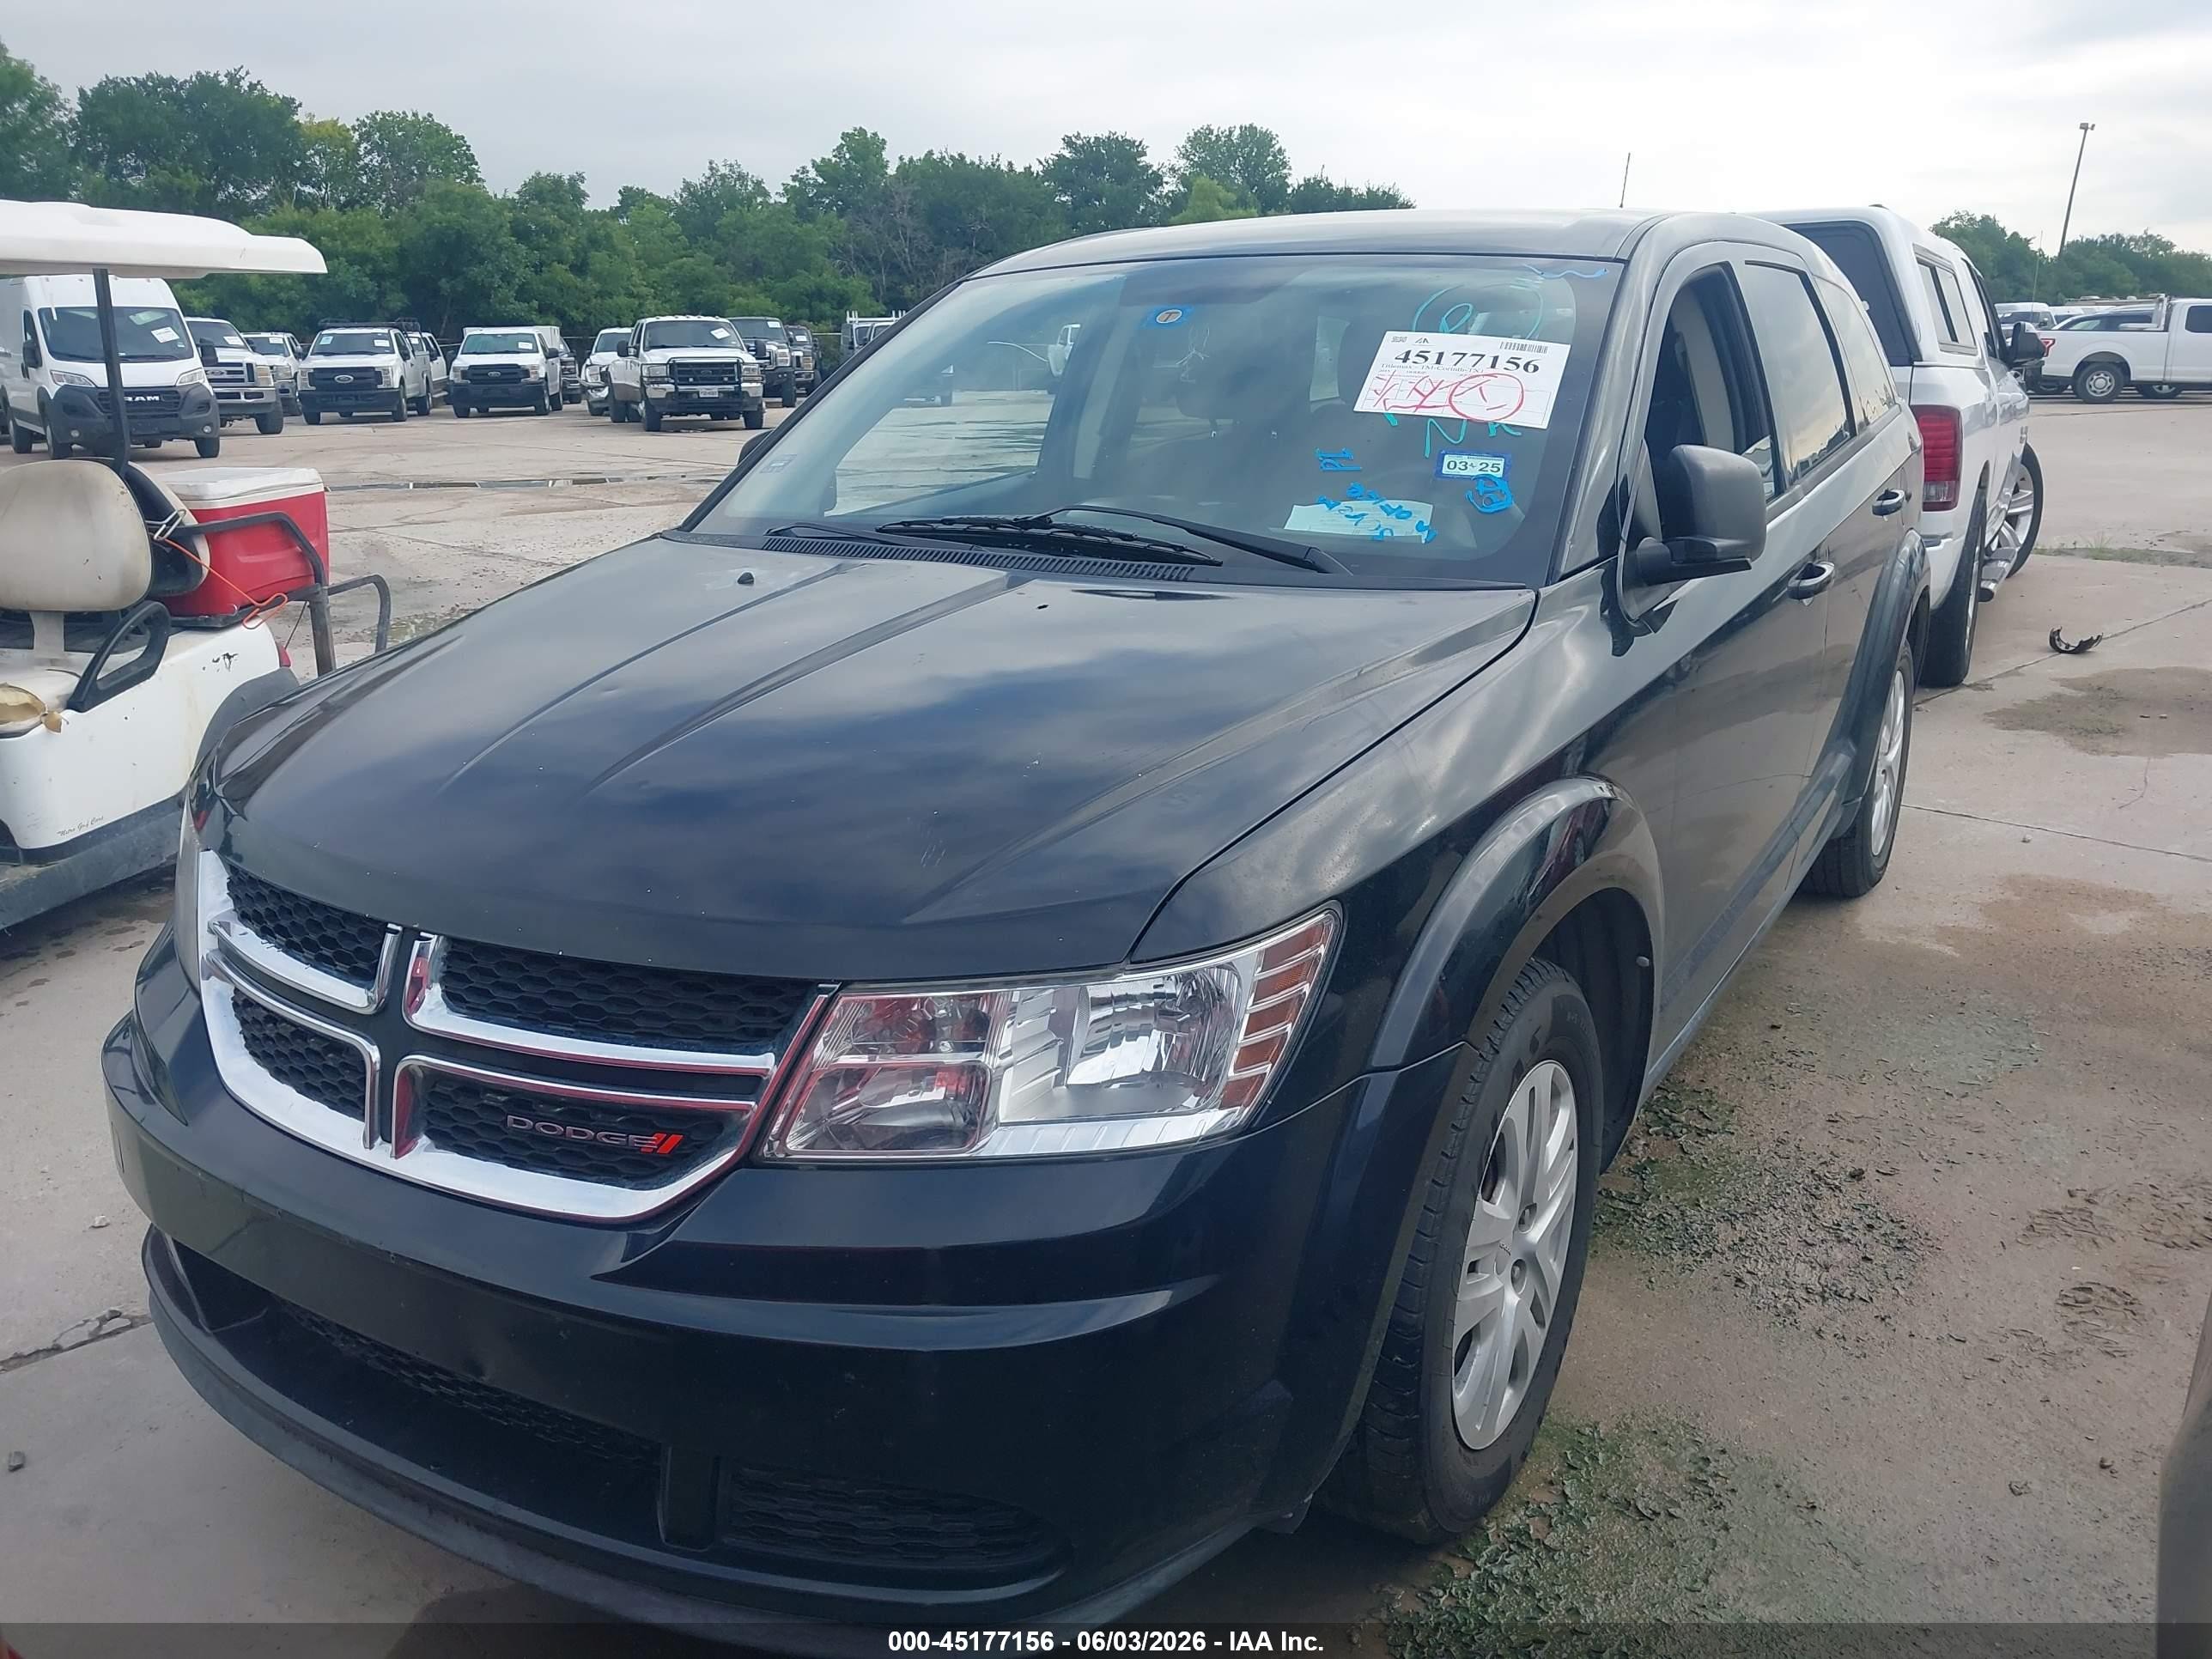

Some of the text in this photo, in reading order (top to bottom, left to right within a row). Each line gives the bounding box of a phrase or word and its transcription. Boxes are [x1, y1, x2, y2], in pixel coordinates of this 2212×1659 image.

[1395, 349, 1540, 374] 45177156
[1478, 462, 1501, 473] 25
[507, 1115, 659, 1148] DODGE
